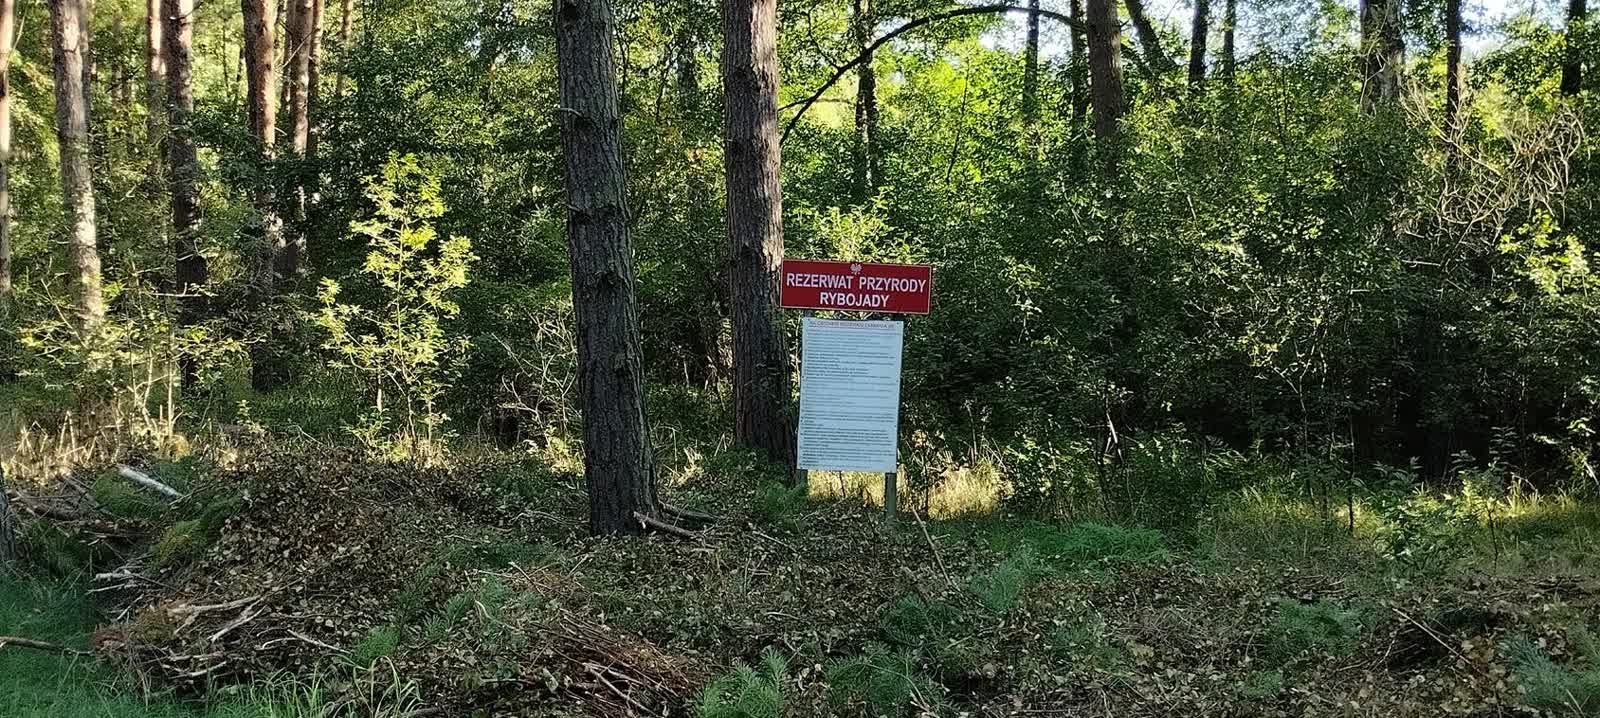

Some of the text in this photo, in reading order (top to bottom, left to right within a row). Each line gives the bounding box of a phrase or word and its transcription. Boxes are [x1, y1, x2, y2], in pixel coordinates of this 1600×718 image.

[786, 272, 926, 293] REZERWAT PRZYRODY
[820, 292, 890, 308] RYBOJADY
